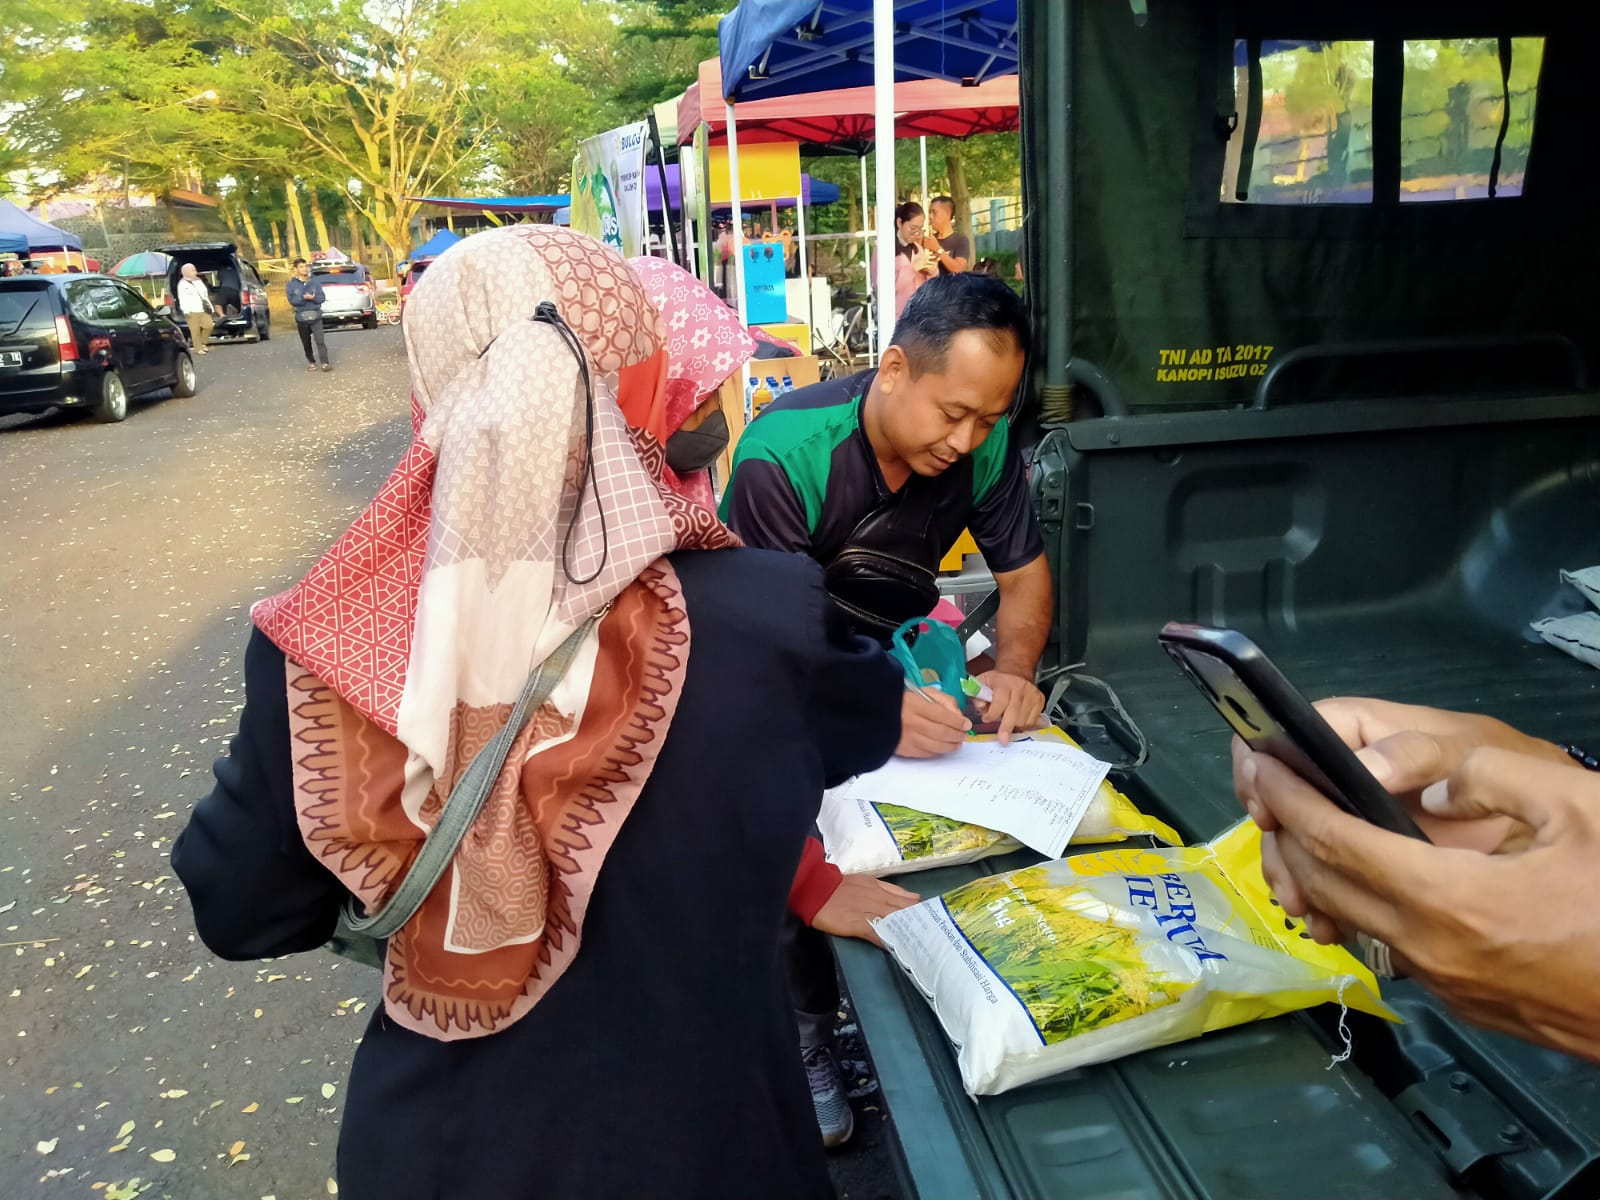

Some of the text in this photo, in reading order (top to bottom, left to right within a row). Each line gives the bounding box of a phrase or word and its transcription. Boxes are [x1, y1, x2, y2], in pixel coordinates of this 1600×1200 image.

[1159, 344, 1274, 366] TNI AD TA 2017
[1156, 368, 1213, 382] KANOPI
[1215, 364, 1247, 380] ISUZU
[960, 949, 987, 982] Stabilisasi
[978, 979, 998, 1005] Harga
